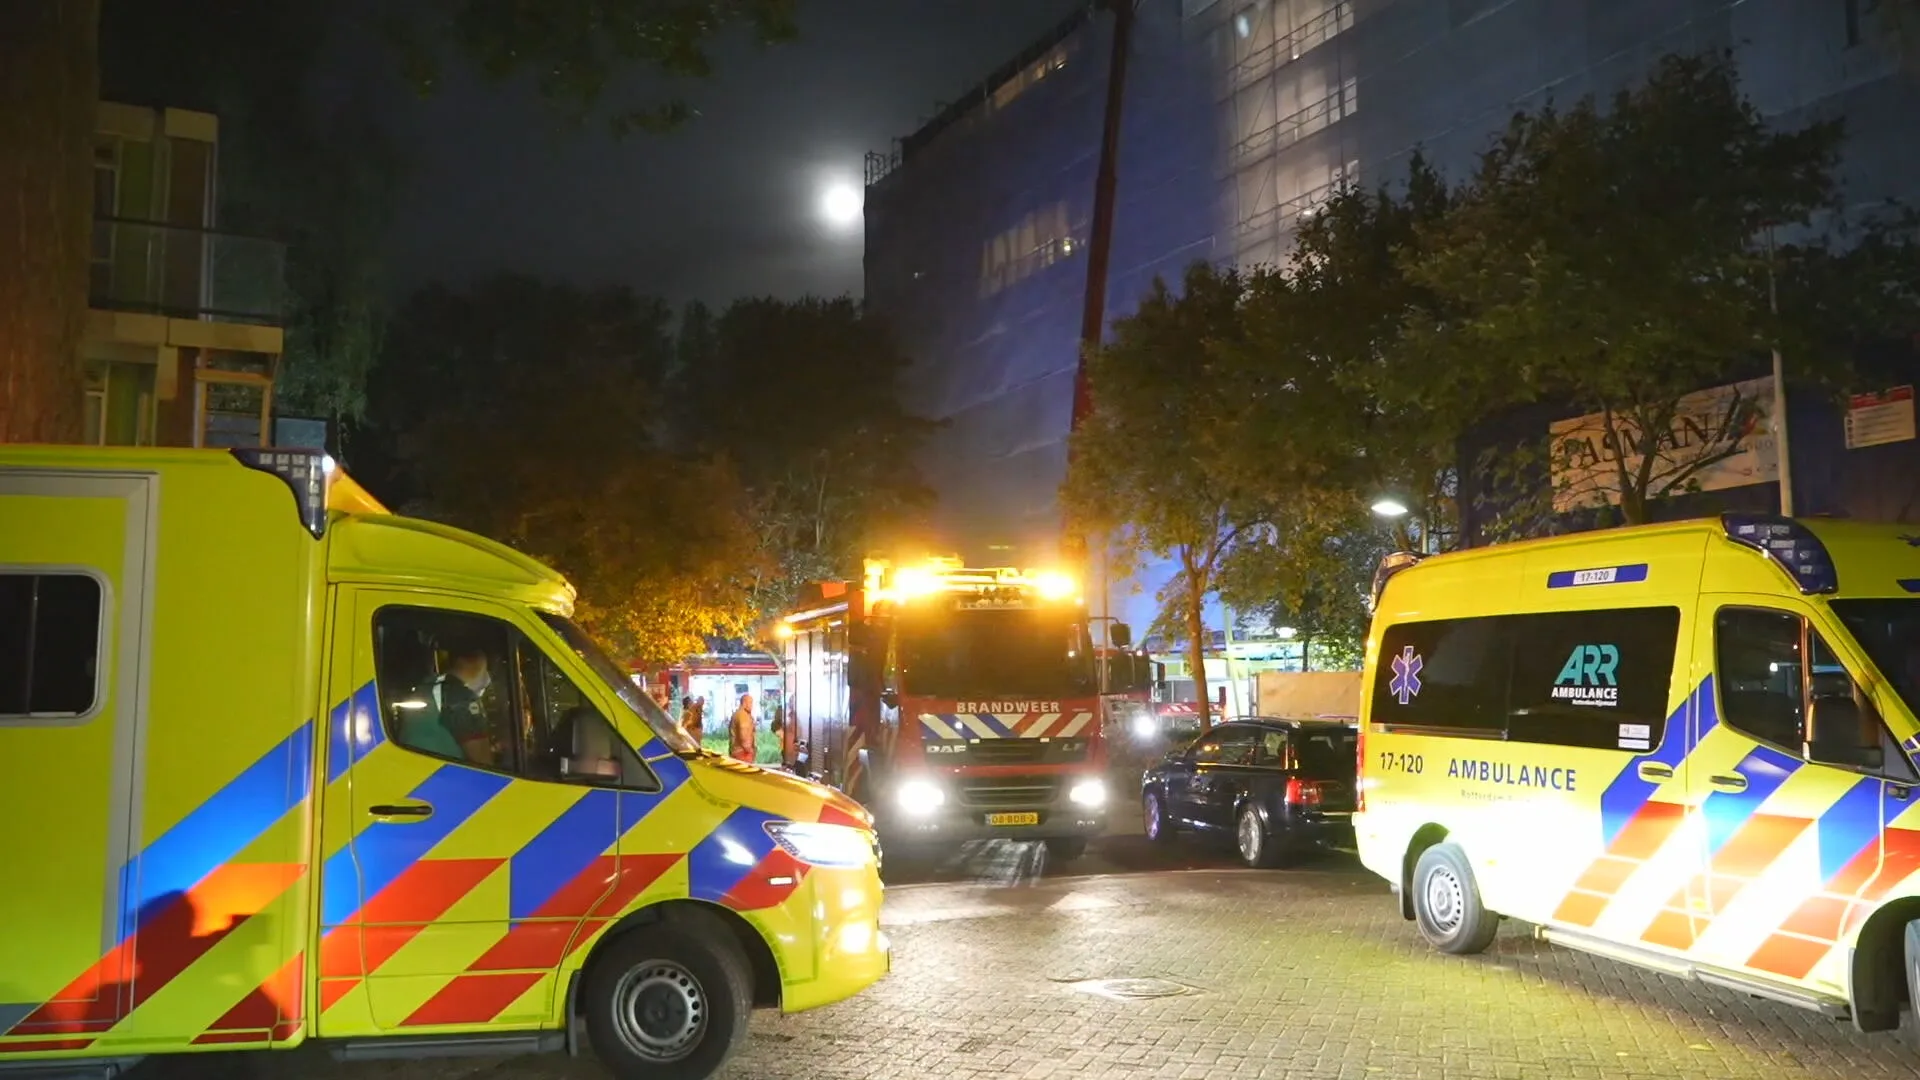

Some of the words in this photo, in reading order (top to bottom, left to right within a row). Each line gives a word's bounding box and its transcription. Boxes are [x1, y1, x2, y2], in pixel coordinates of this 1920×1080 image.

[1581, 571, 1609, 581] 17-120
[1554, 644, 1619, 685] ARR
[1551, 687, 1618, 699] AMBULANCE
[956, 701, 1060, 714] BRANDWEER
[926, 744, 967, 754] DAF
[1379, 752, 1424, 774] 17-120
[1448, 758, 1576, 791] AMBULANCE
